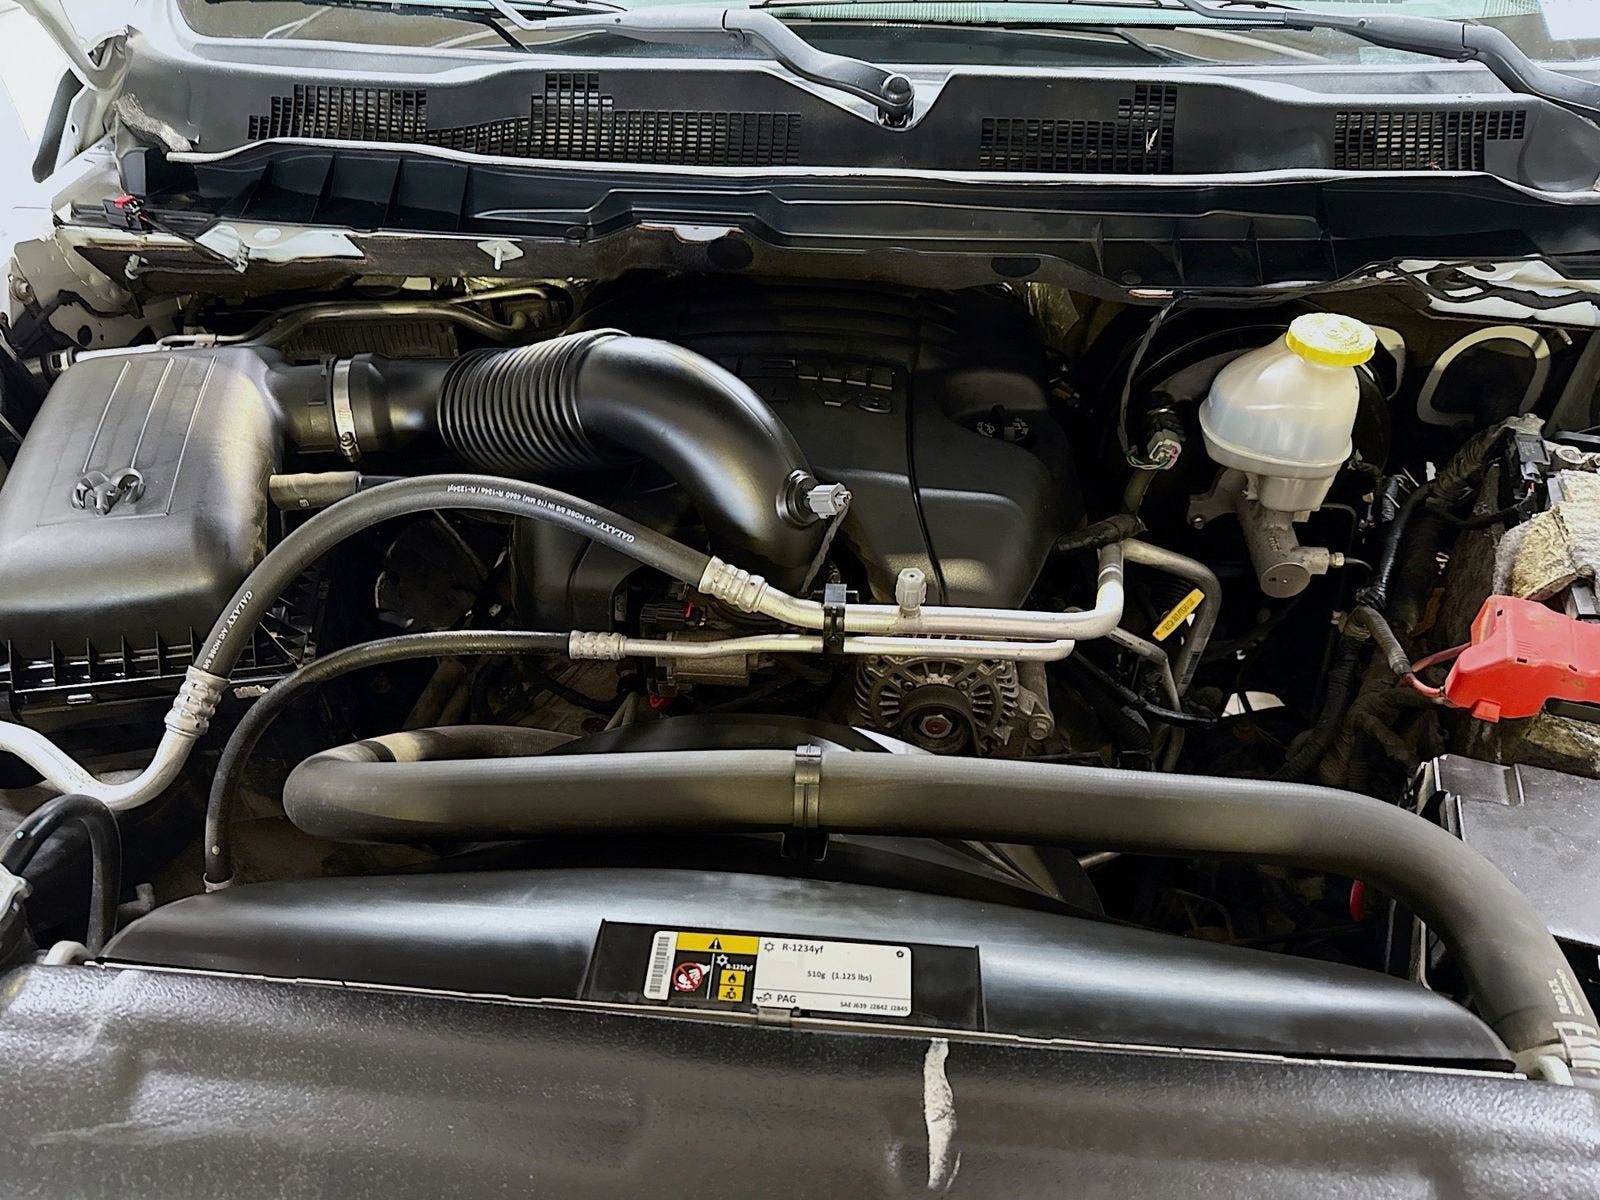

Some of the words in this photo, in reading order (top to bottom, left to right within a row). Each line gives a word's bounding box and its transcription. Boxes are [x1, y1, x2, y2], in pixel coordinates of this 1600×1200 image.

[566, 508, 585, 521] HOSE
[585, 516, 597, 526] A/C
[598, 522, 635, 543] GALAXY
[227, 590, 253, 628] GALAXY
[218, 627, 228, 640] A/C
[208, 639, 222, 659] HOSE
[782, 943, 824, 955] R-1234yf
[807, 970, 826, 979] 510g
[831, 971, 856, 981] (1.125
[857, 973, 872, 982] lbs)
[777, 994, 797, 1004] PAG
